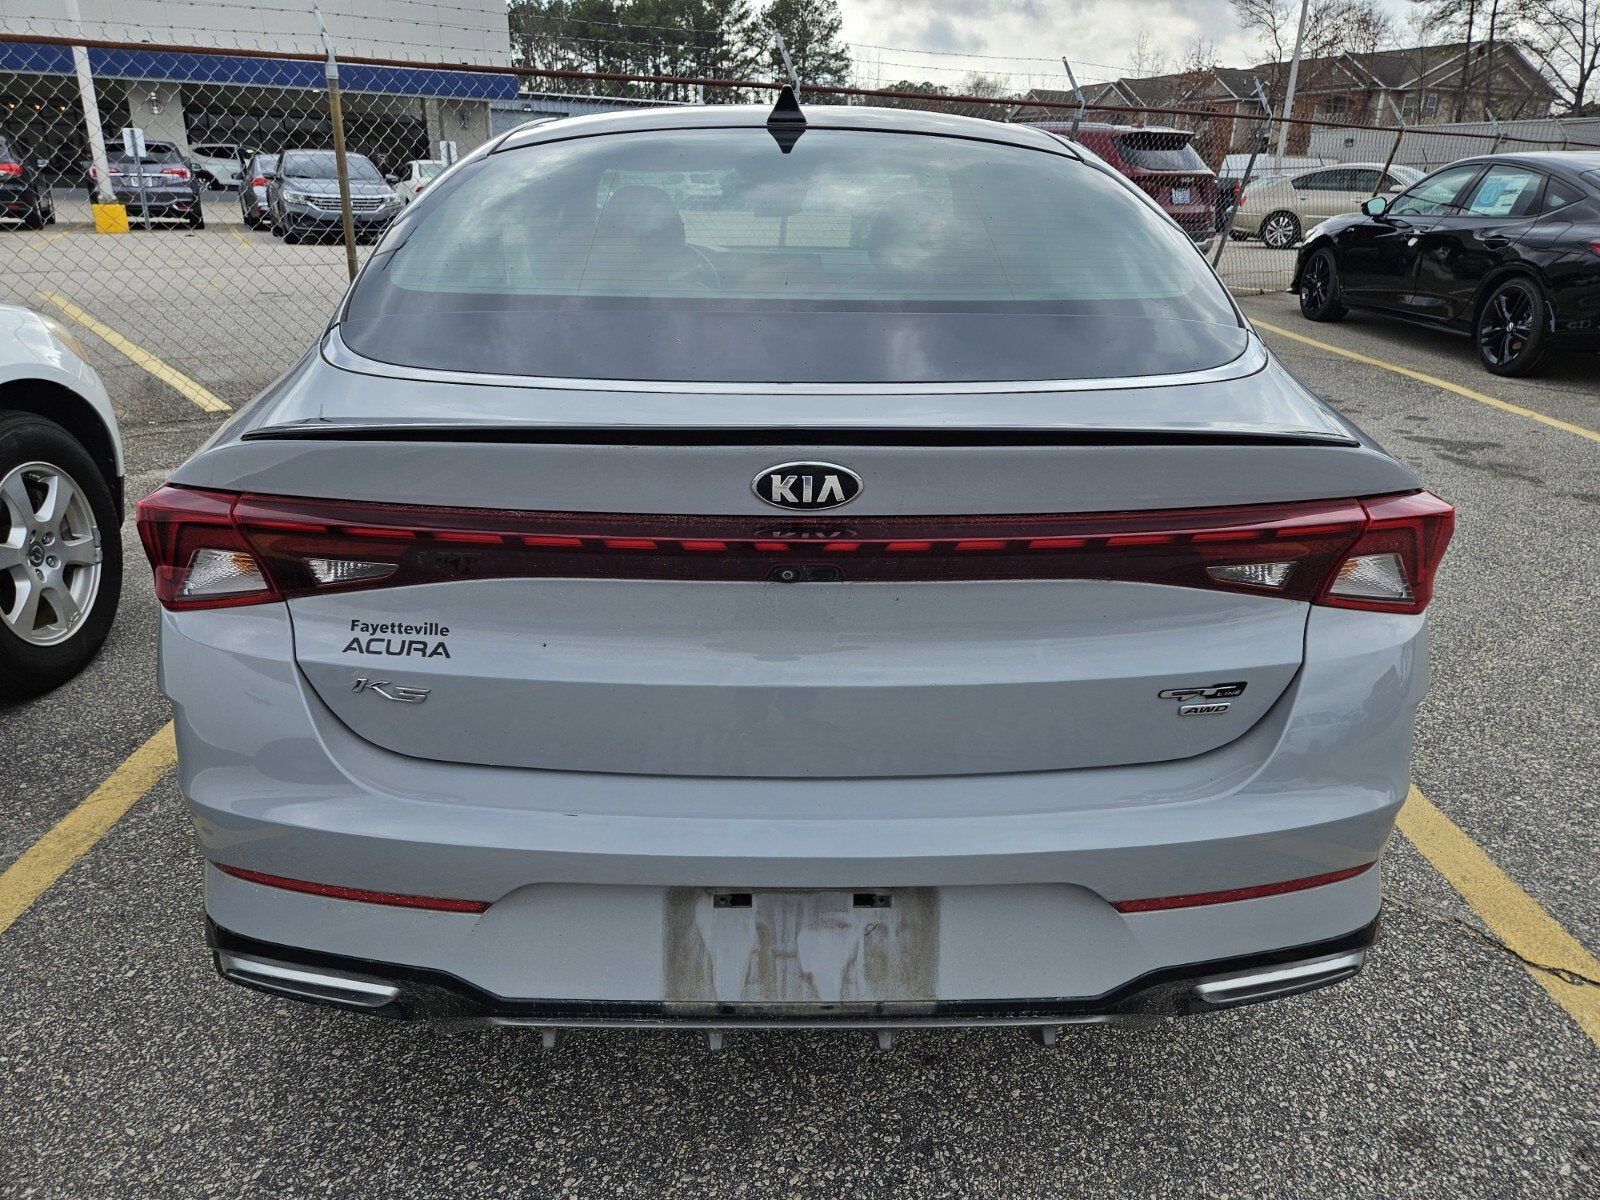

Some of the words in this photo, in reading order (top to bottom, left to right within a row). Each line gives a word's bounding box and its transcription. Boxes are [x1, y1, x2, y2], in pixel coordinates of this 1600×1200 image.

[771, 474, 846, 503] KIA
[350, 619, 450, 637] Fayetteville
[342, 637, 451, 659] ACURA
[352, 678, 431, 703] K5
[1183, 705, 1228, 715] AWD
